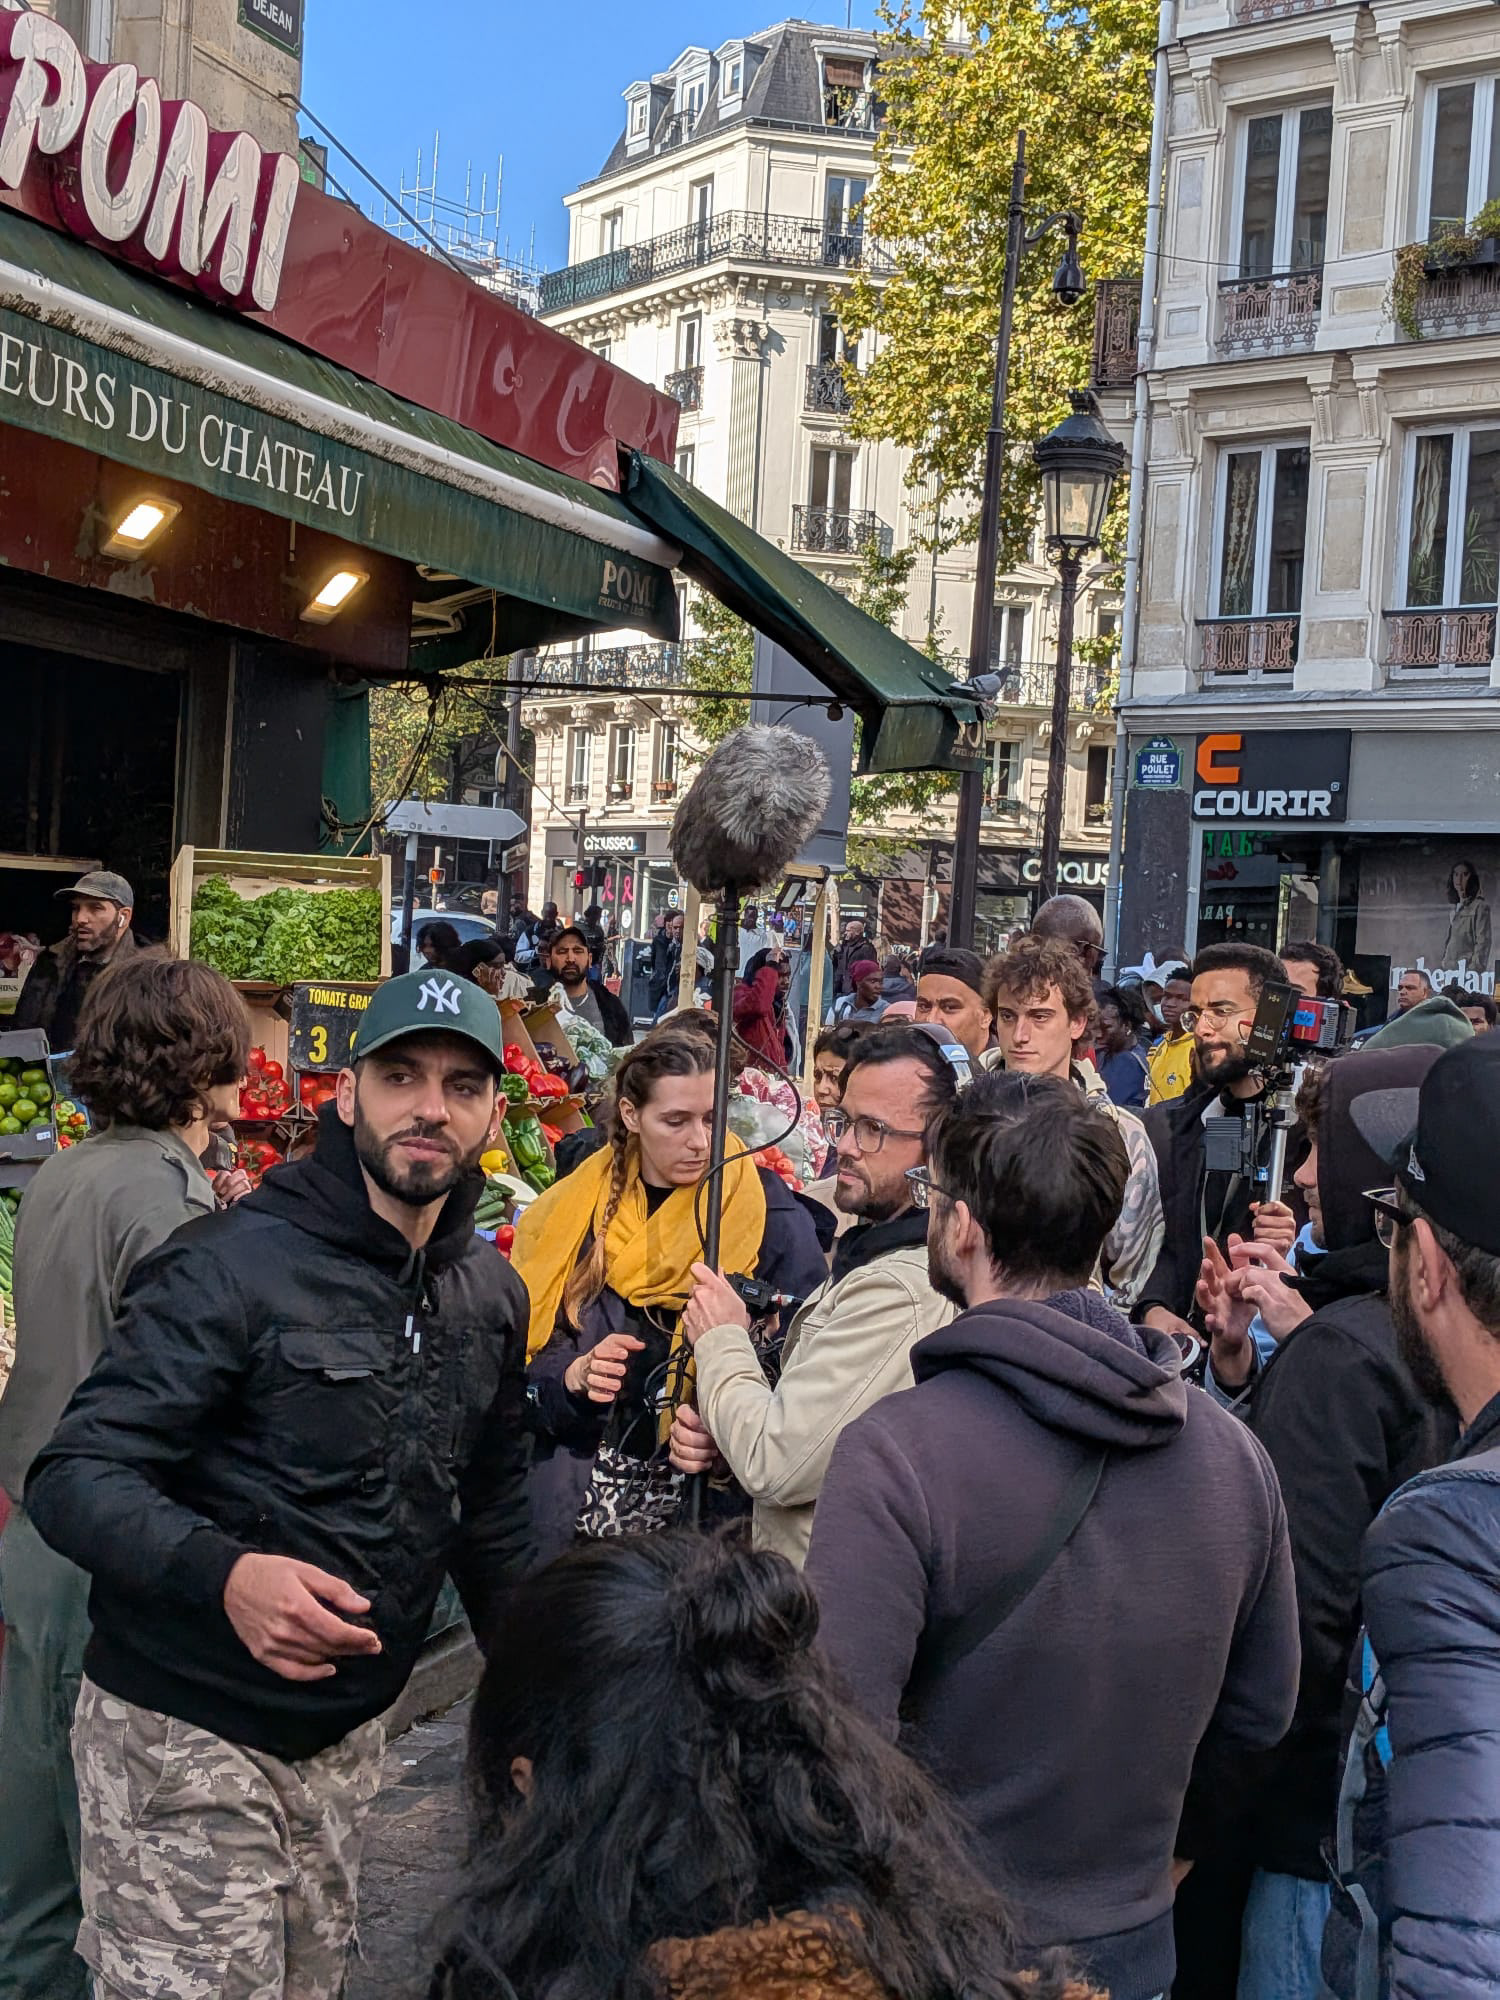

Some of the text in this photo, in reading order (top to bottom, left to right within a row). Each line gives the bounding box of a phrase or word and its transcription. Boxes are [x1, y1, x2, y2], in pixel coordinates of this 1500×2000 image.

[0, 12, 300, 311] POMI
[0, 333, 364, 516] EURS DU CHATEAU
[1141, 764, 1175, 774] POULET
[1150, 754, 1167, 764] RUE
[1194, 790, 1332, 816] COURIR
[309, 988, 373, 1010] TOMATE GRA
[417, 977, 462, 1015] NY
[309, 1025, 327, 1063] 3
